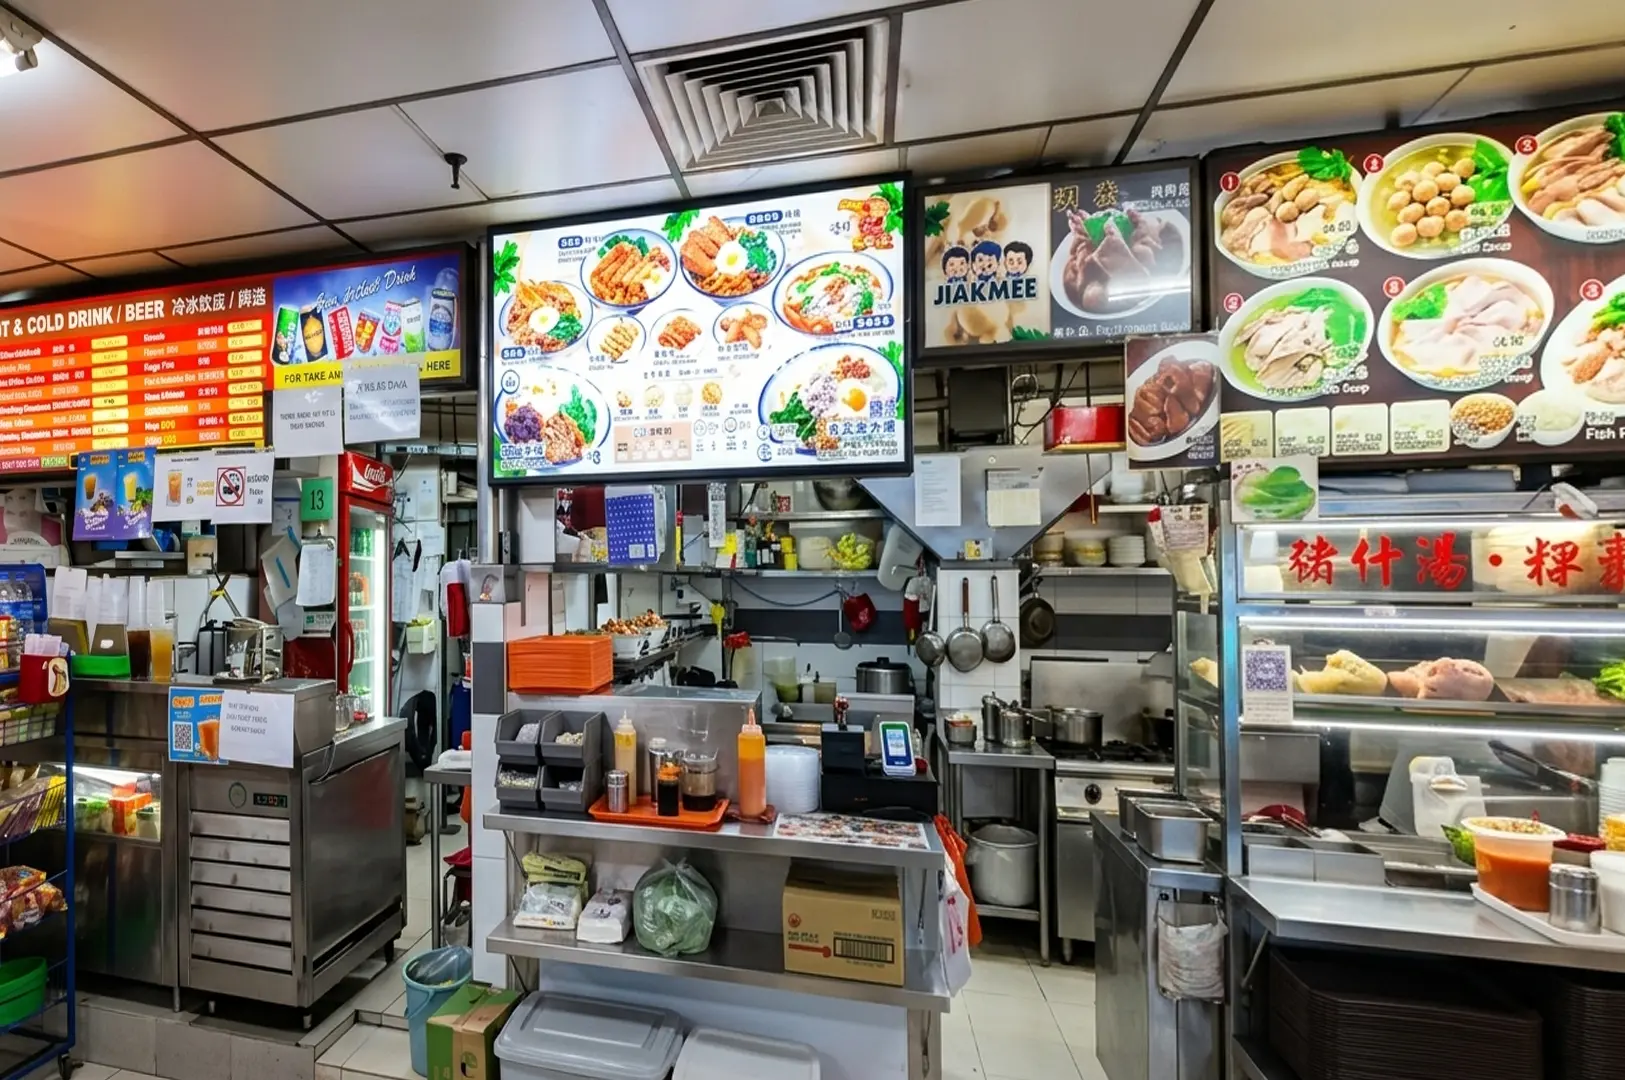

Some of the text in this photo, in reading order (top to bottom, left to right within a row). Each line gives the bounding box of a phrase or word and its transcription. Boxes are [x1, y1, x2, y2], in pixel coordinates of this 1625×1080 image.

[934, 278, 1036, 305] JIAKMEE
[13, 318, 23, 336] &
[27, 313, 64, 334] COLD
[68, 306, 113, 329] DRINK
[116, 304, 122, 323] /
[125, 300, 165, 322] BEER
[304, 371, 326, 382] TAKE
[426, 360, 451, 371] HERE
[310, 489, 324, 511] 13
